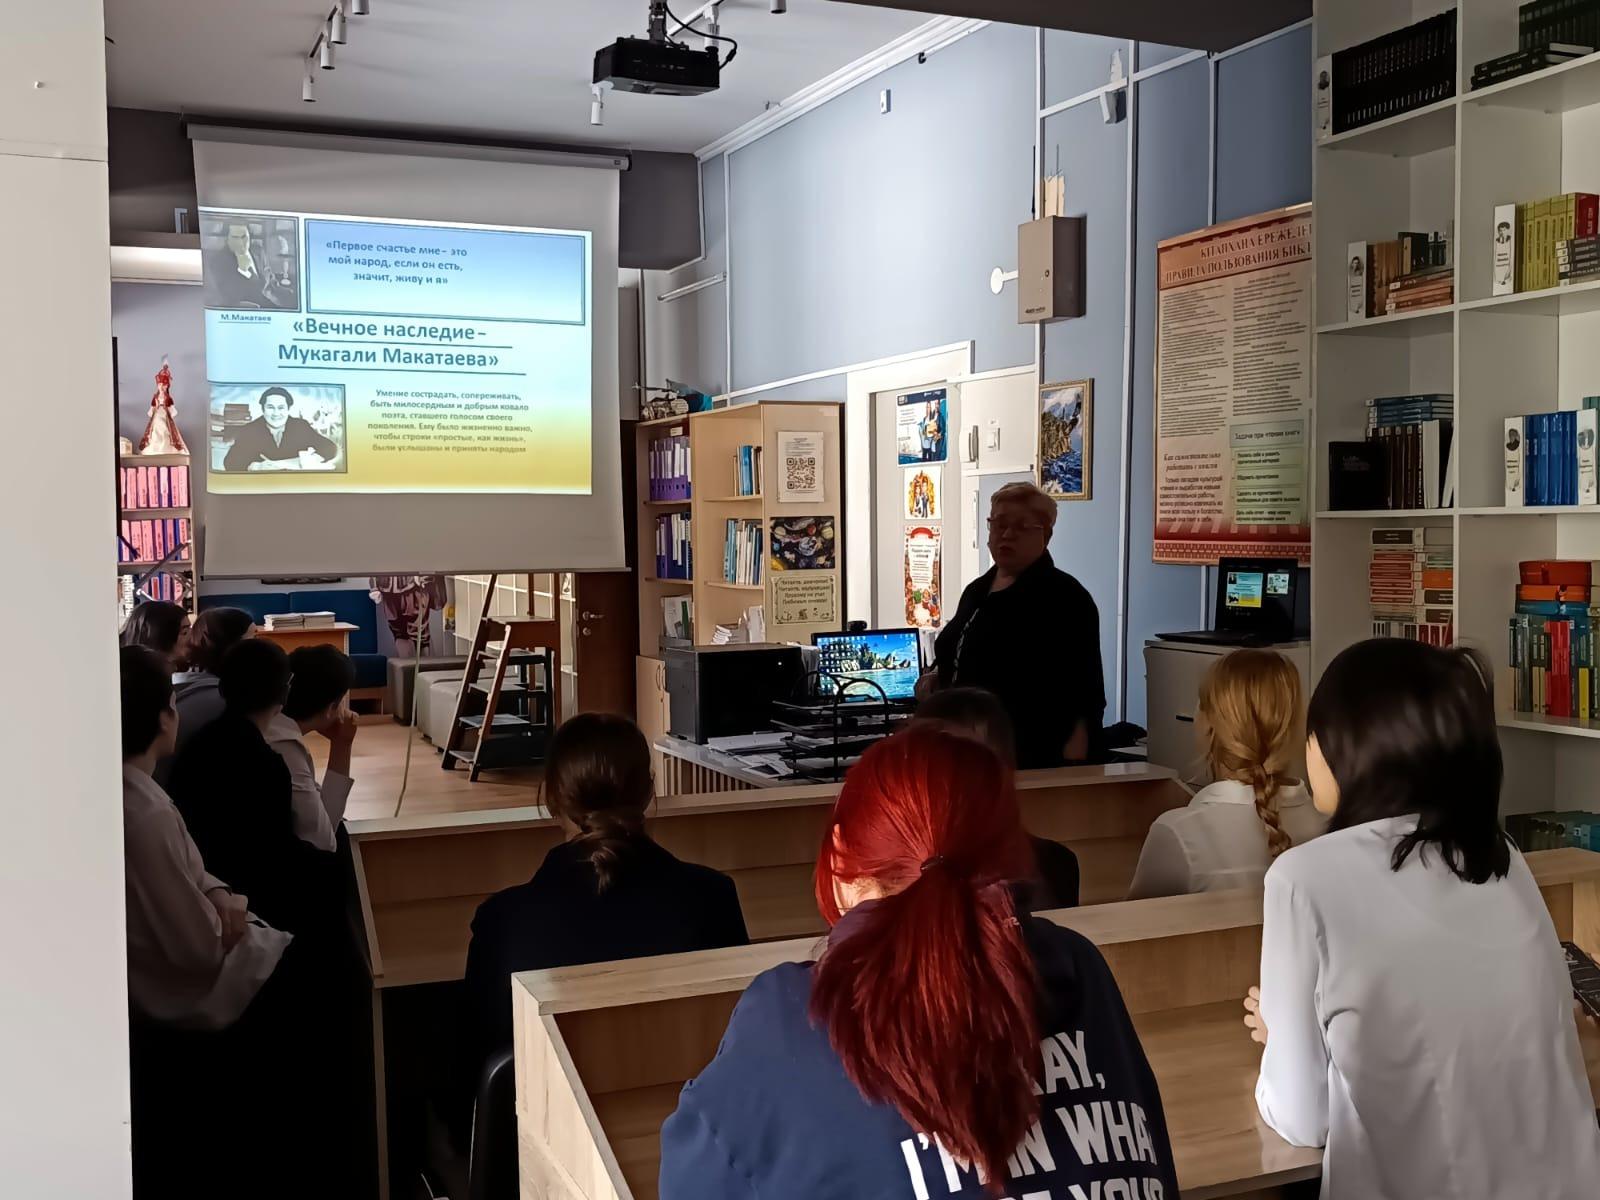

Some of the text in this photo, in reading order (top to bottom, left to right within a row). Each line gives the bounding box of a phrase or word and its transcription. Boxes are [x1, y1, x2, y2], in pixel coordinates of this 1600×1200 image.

[326, 240, 374, 252] «Первое
[376, 245, 416, 254] счастье
[451, 248, 467, 257] это
[328, 255, 463, 272] мой народ, если он есть,
[1207, 249, 1279, 272] ПОЛЬЗОВАНИЯ
[353, 272, 392, 283] значит,
[395, 275, 423, 285] живу
[426, 276, 433, 284] и
[293, 317, 378, 337] «Вечное
[278, 343, 499, 368] Мукагали Макатаева»
[375, 389, 521, 401] Умение сострадать, сопереживать,
[370, 399, 391, 408] быть
[393, 401, 454, 410] милосердным
[464, 402, 499, 411] добрым
[410, 412, 448, 420] ставшего
[450, 413, 484, 421] голосом
[486, 414, 513, 422] своего
[1032, 1030, 1106, 1096] AY,
